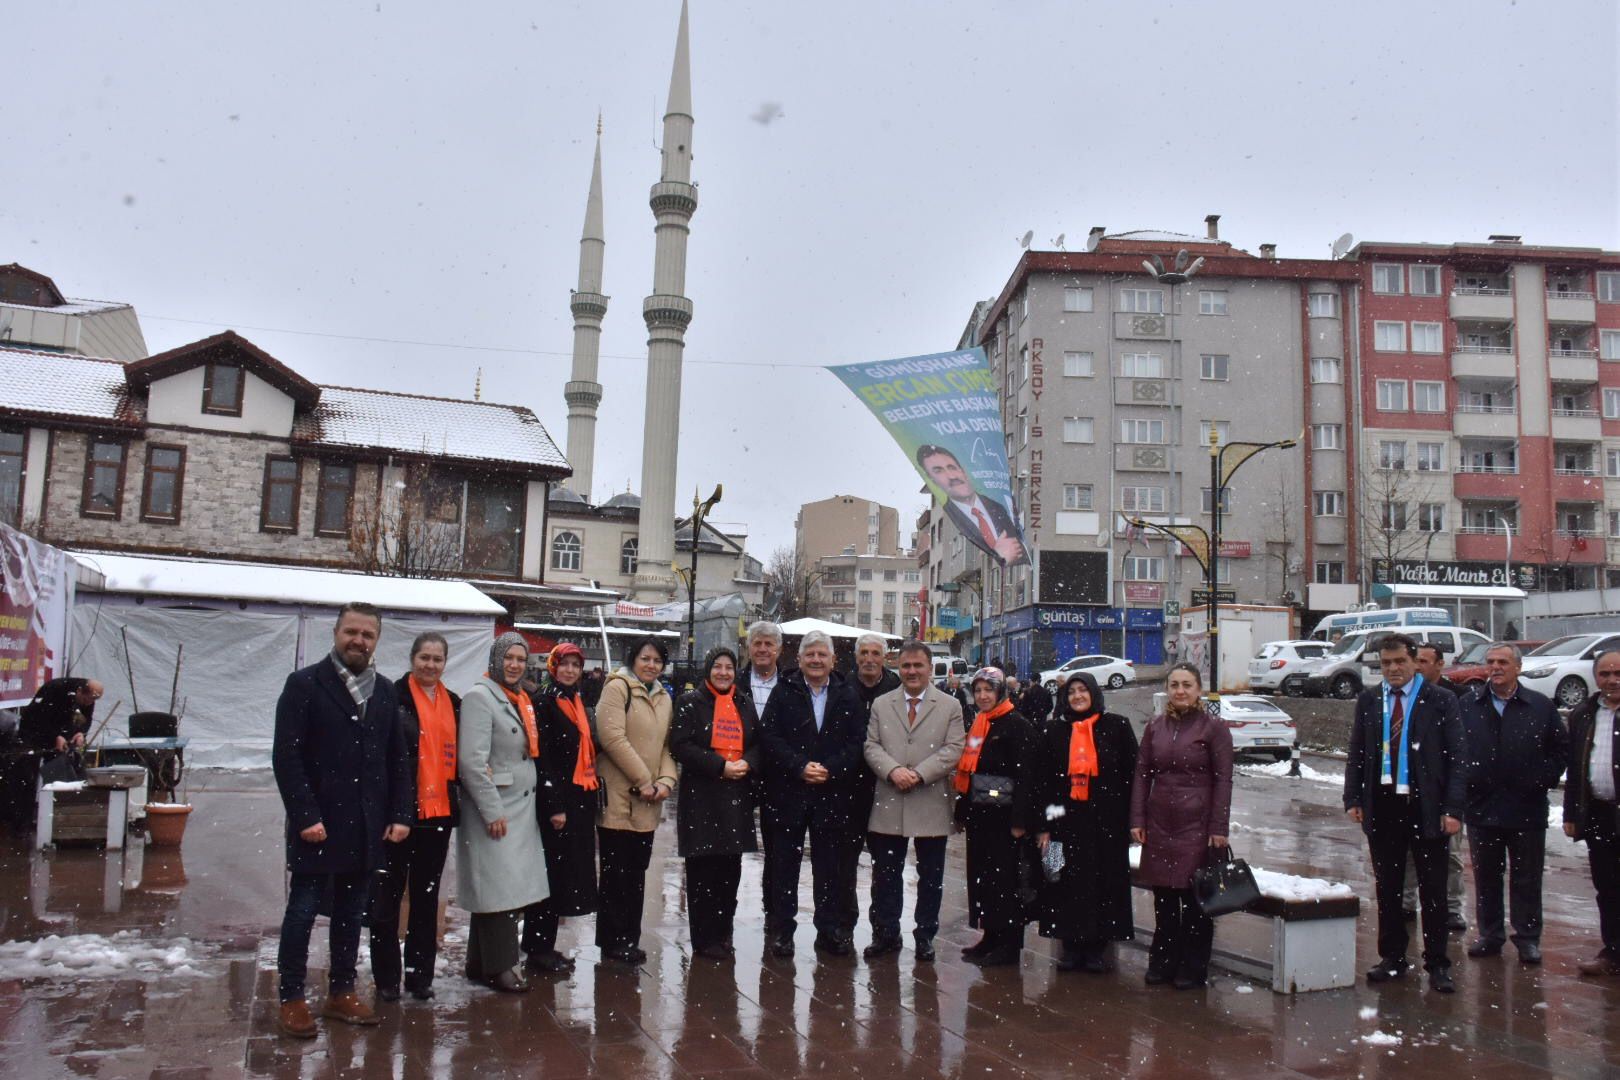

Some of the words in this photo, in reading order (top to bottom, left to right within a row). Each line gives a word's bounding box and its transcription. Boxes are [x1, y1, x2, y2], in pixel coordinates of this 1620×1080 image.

[864, 353, 980, 379] GÜMÜŞHANE
[1031, 338, 1043, 401] AKSOY
[860, 373, 950, 406] ERCAN
[883, 399, 955, 424] BELEDİYE
[930, 418, 971, 435] YOLA
[967, 416, 1002, 433] DEVA
[1042, 610, 1086, 626] güntaş
